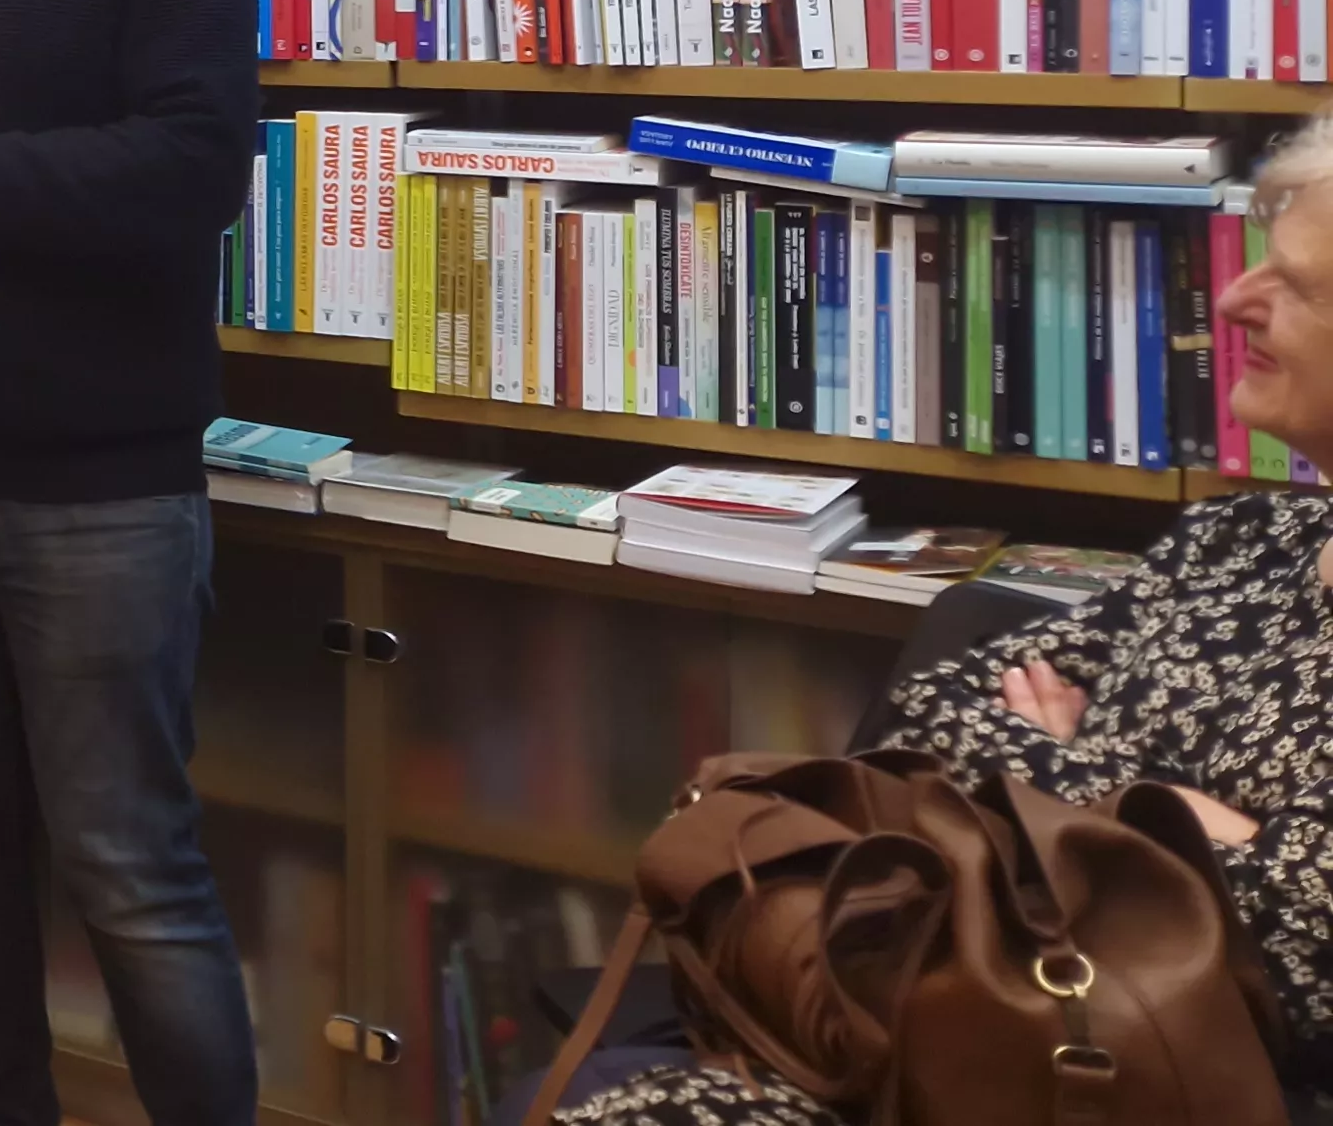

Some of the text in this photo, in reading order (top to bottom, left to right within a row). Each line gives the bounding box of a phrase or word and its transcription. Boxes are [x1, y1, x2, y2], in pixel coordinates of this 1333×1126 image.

[901, 21, 923, 45] JEAN
[417, 151, 555, 174] CARLOS SAURA
[686, 138, 814, 167] NUESTRO CUERPO
[321, 124, 339, 247] CARLOS SAURA
[349, 125, 368, 248] CARLOS SAURA
[377, 126, 395, 250] CARLOS SAURA
[662, 250, 672, 268] TUS
[662, 268, 672, 314] SOMBRAS
